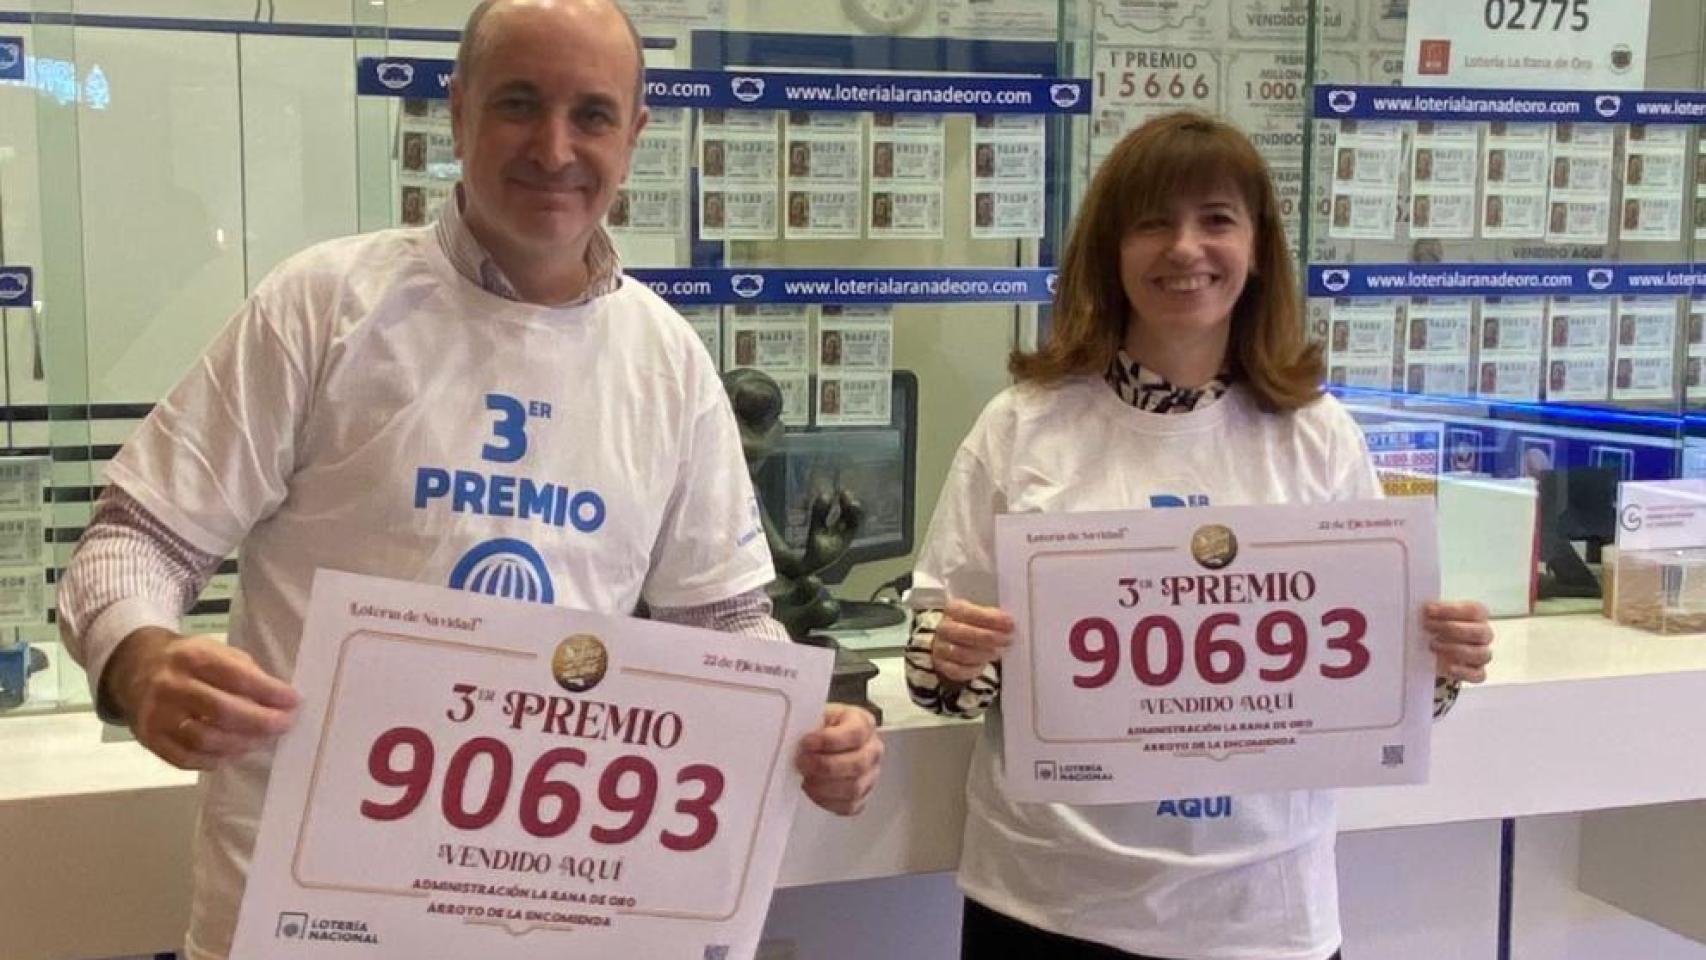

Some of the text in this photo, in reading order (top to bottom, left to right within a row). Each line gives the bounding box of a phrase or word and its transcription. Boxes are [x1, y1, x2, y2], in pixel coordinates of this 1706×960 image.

[1485, 0, 1590, 32] 02775
[1126, 53, 1197, 69] PREMIO
[785, 83, 1032, 104] www.loterialaranadeoro.com
[1373, 96, 1580, 114] www.loterialaranadeoro.com
[785, 277, 1028, 295] www.loterialaranadeoro.com
[1367, 270, 1572, 288] www.loterialaranadeoro.com
[414, 467, 607, 533] PREMIO
[1161, 571, 1316, 605] PREMIO
[403, 608, 419, 622] de
[1068, 607, 1371, 689] 90693
[718, 656, 732, 668] de
[1140, 696, 1234, 714] VENDIDO
[503, 688, 684, 750] PREMIO
[1224, 722, 1237, 732] LA
[1239, 721, 1270, 731] RANA
[1273, 720, 1286, 729] DE
[1289, 720, 1313, 728] ORO
[1143, 742, 1188, 752] ARROYO
[1191, 741, 1205, 750] DE
[1208, 740, 1220, 749] LA
[360, 726, 726, 852] 90693
[437, 843, 551, 873] VENDIDO
[532, 888, 547, 900] LA
[550, 890, 586, 904] RANA
[589, 894, 605, 906] DE
[609, 896, 636, 907] ORO
[427, 902, 611, 927] ARROYO DE LA ENCOMIENDA
[308, 931, 378, 944] NACIONAL
